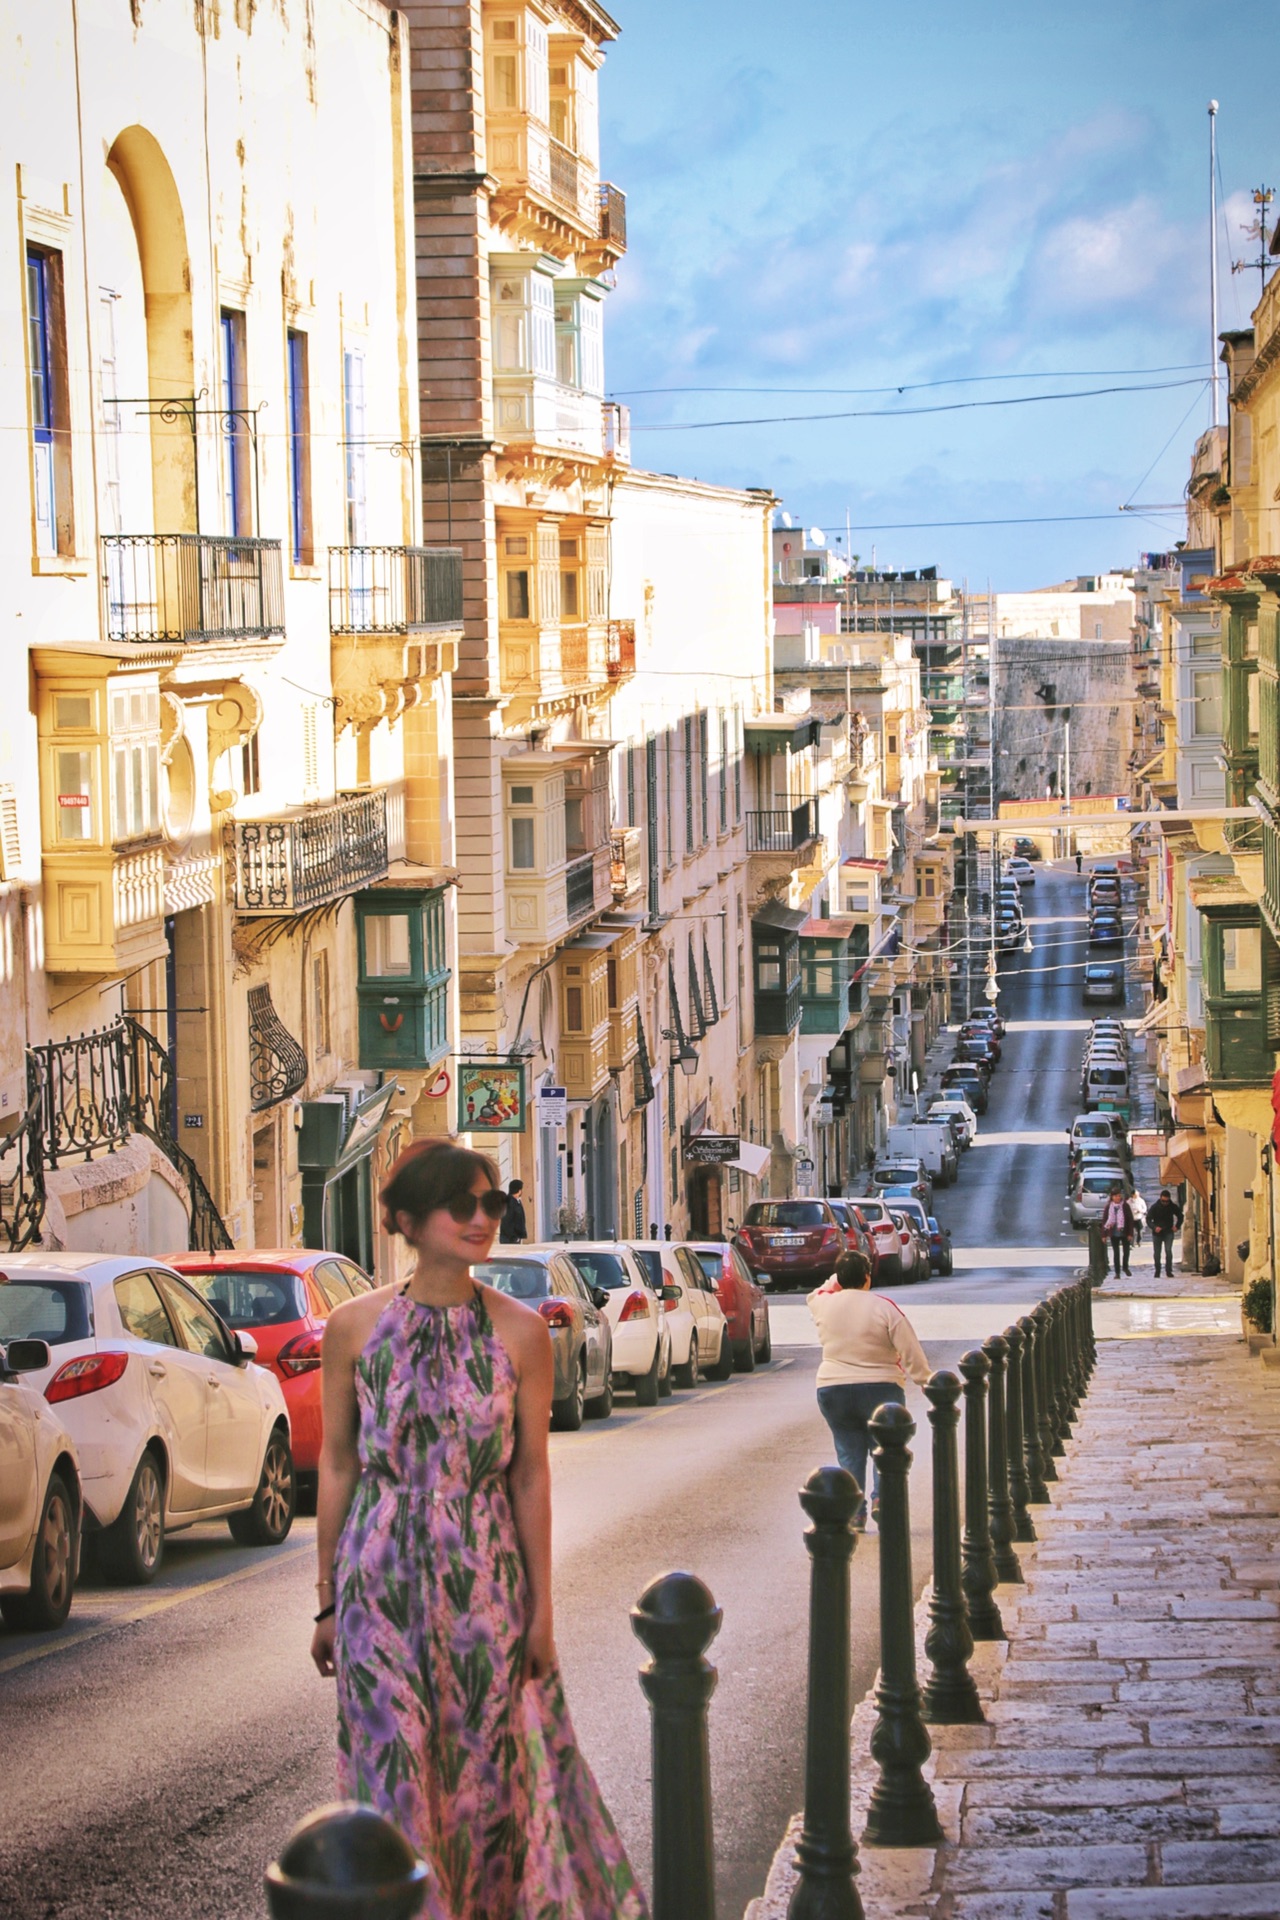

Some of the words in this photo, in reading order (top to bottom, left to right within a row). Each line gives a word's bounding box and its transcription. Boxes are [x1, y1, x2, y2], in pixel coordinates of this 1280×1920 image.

[185, 1116, 202, 1127] 224
[709, 1140, 724, 1148] The
[700, 1153, 722, 1164] Shop
